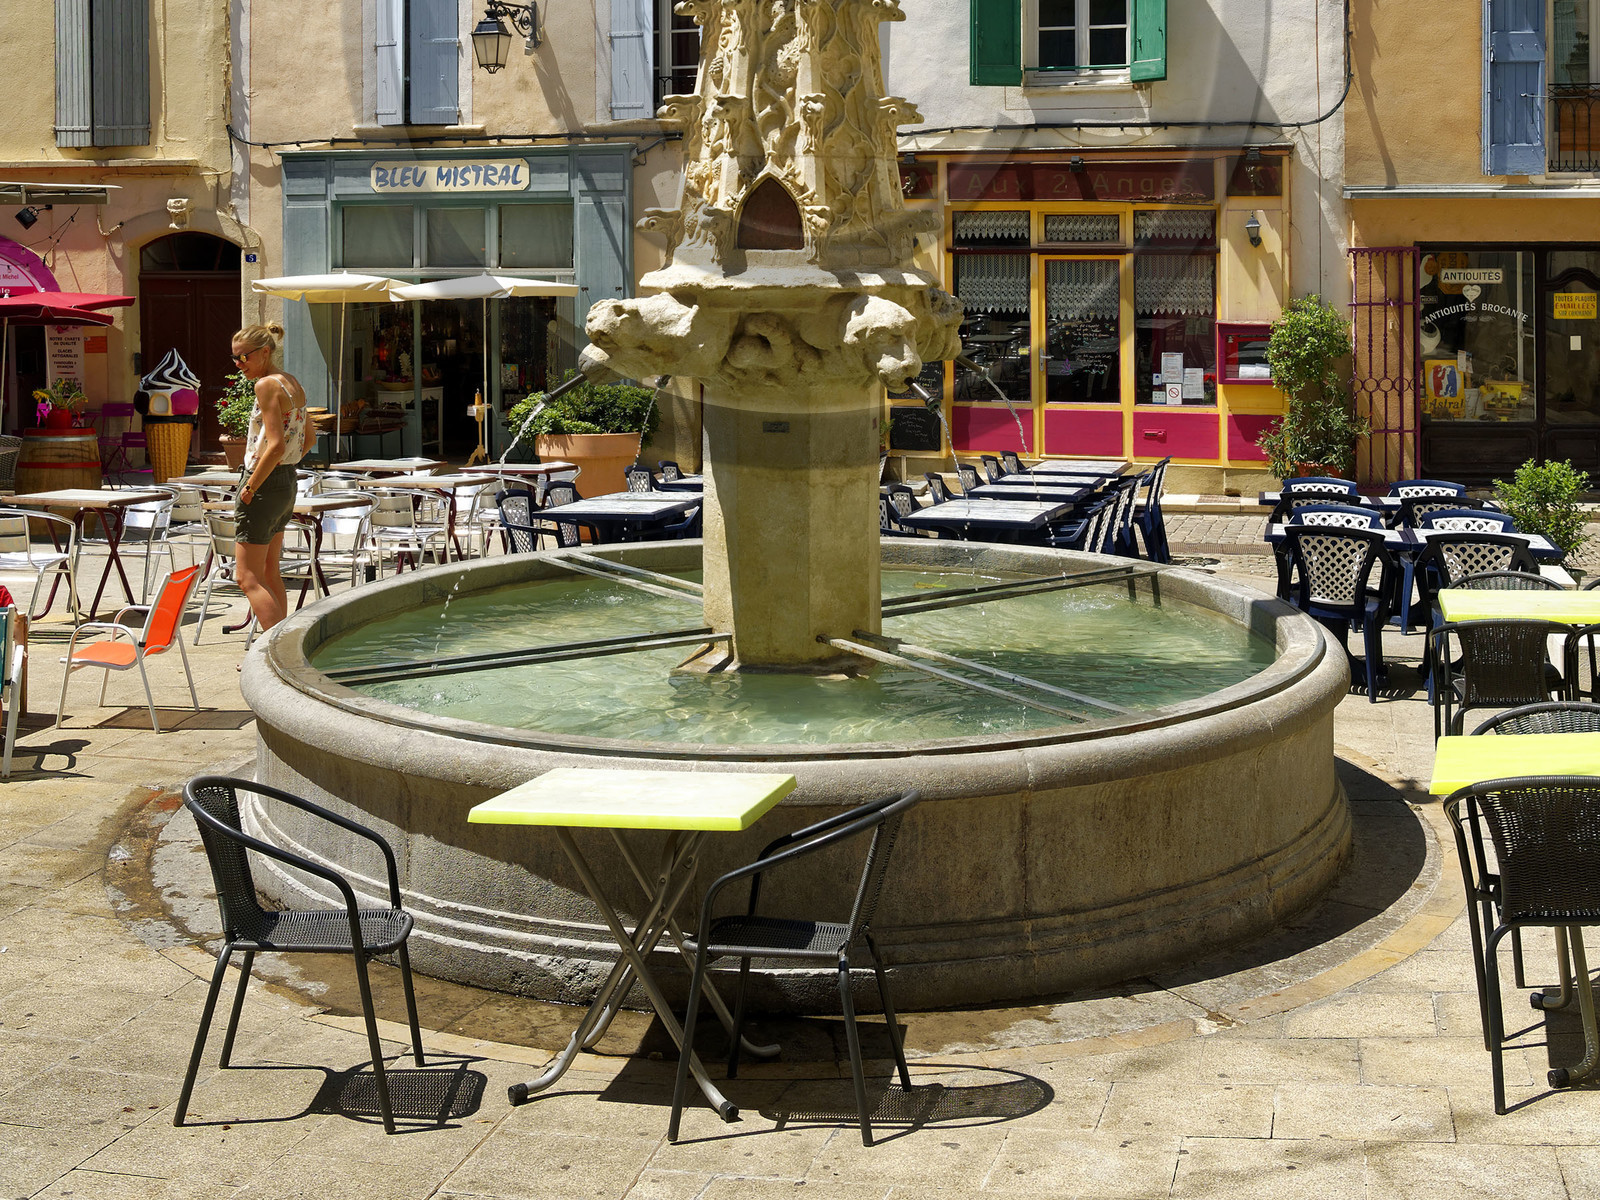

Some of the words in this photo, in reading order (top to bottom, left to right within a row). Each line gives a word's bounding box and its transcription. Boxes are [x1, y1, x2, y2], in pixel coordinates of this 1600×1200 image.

[375, 166, 427, 188] BLEU
[436, 165, 523, 187] MISTRAL
[967, 173, 1027, 194] Aux
[1053, 173, 1068, 194] 2
[1092, 173, 1194, 197] Anges
[1443, 271, 1501, 280] ANTIQUITÉS
[1424, 302, 1476, 324] ANTIQUITÉS
[1481, 302, 1529, 322] BROCANTE
[1429, 398, 1464, 409] Astral
